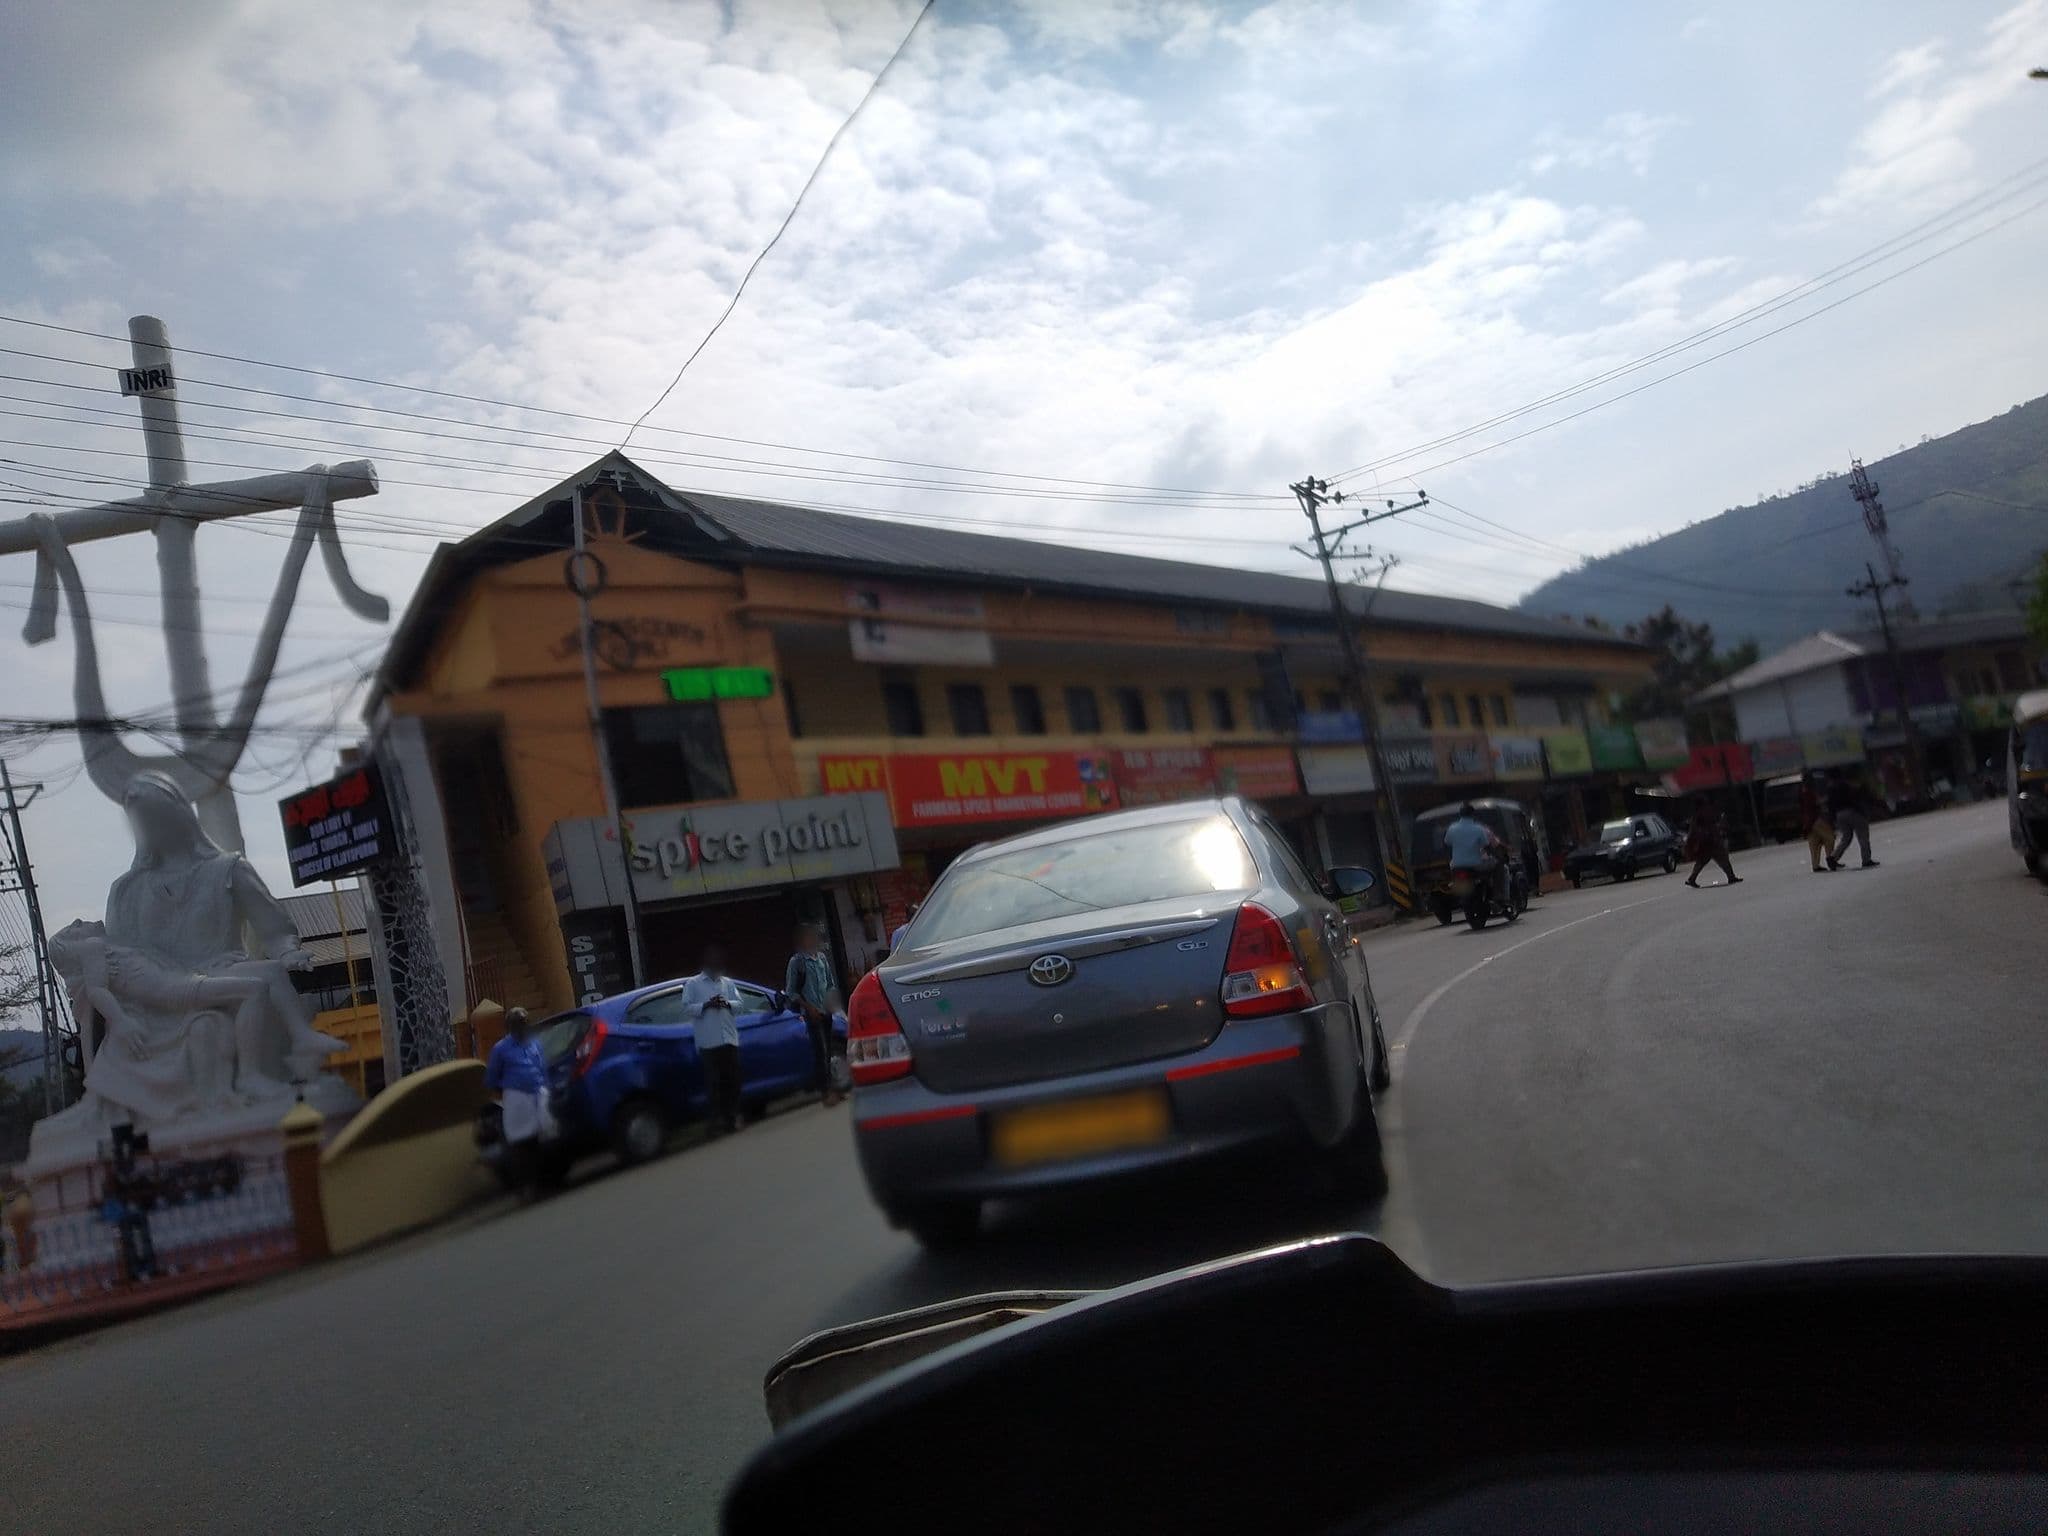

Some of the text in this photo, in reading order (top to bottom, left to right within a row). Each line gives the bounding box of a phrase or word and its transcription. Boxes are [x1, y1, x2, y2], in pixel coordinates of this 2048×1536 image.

[126, 369, 168, 391] INRI
[825, 760, 879, 789] MVT
[938, 756, 1050, 797] MVT
[630, 814, 749, 880] spice
[761, 811, 859, 866] point
[901, 988, 941, 1003] ETIOS
